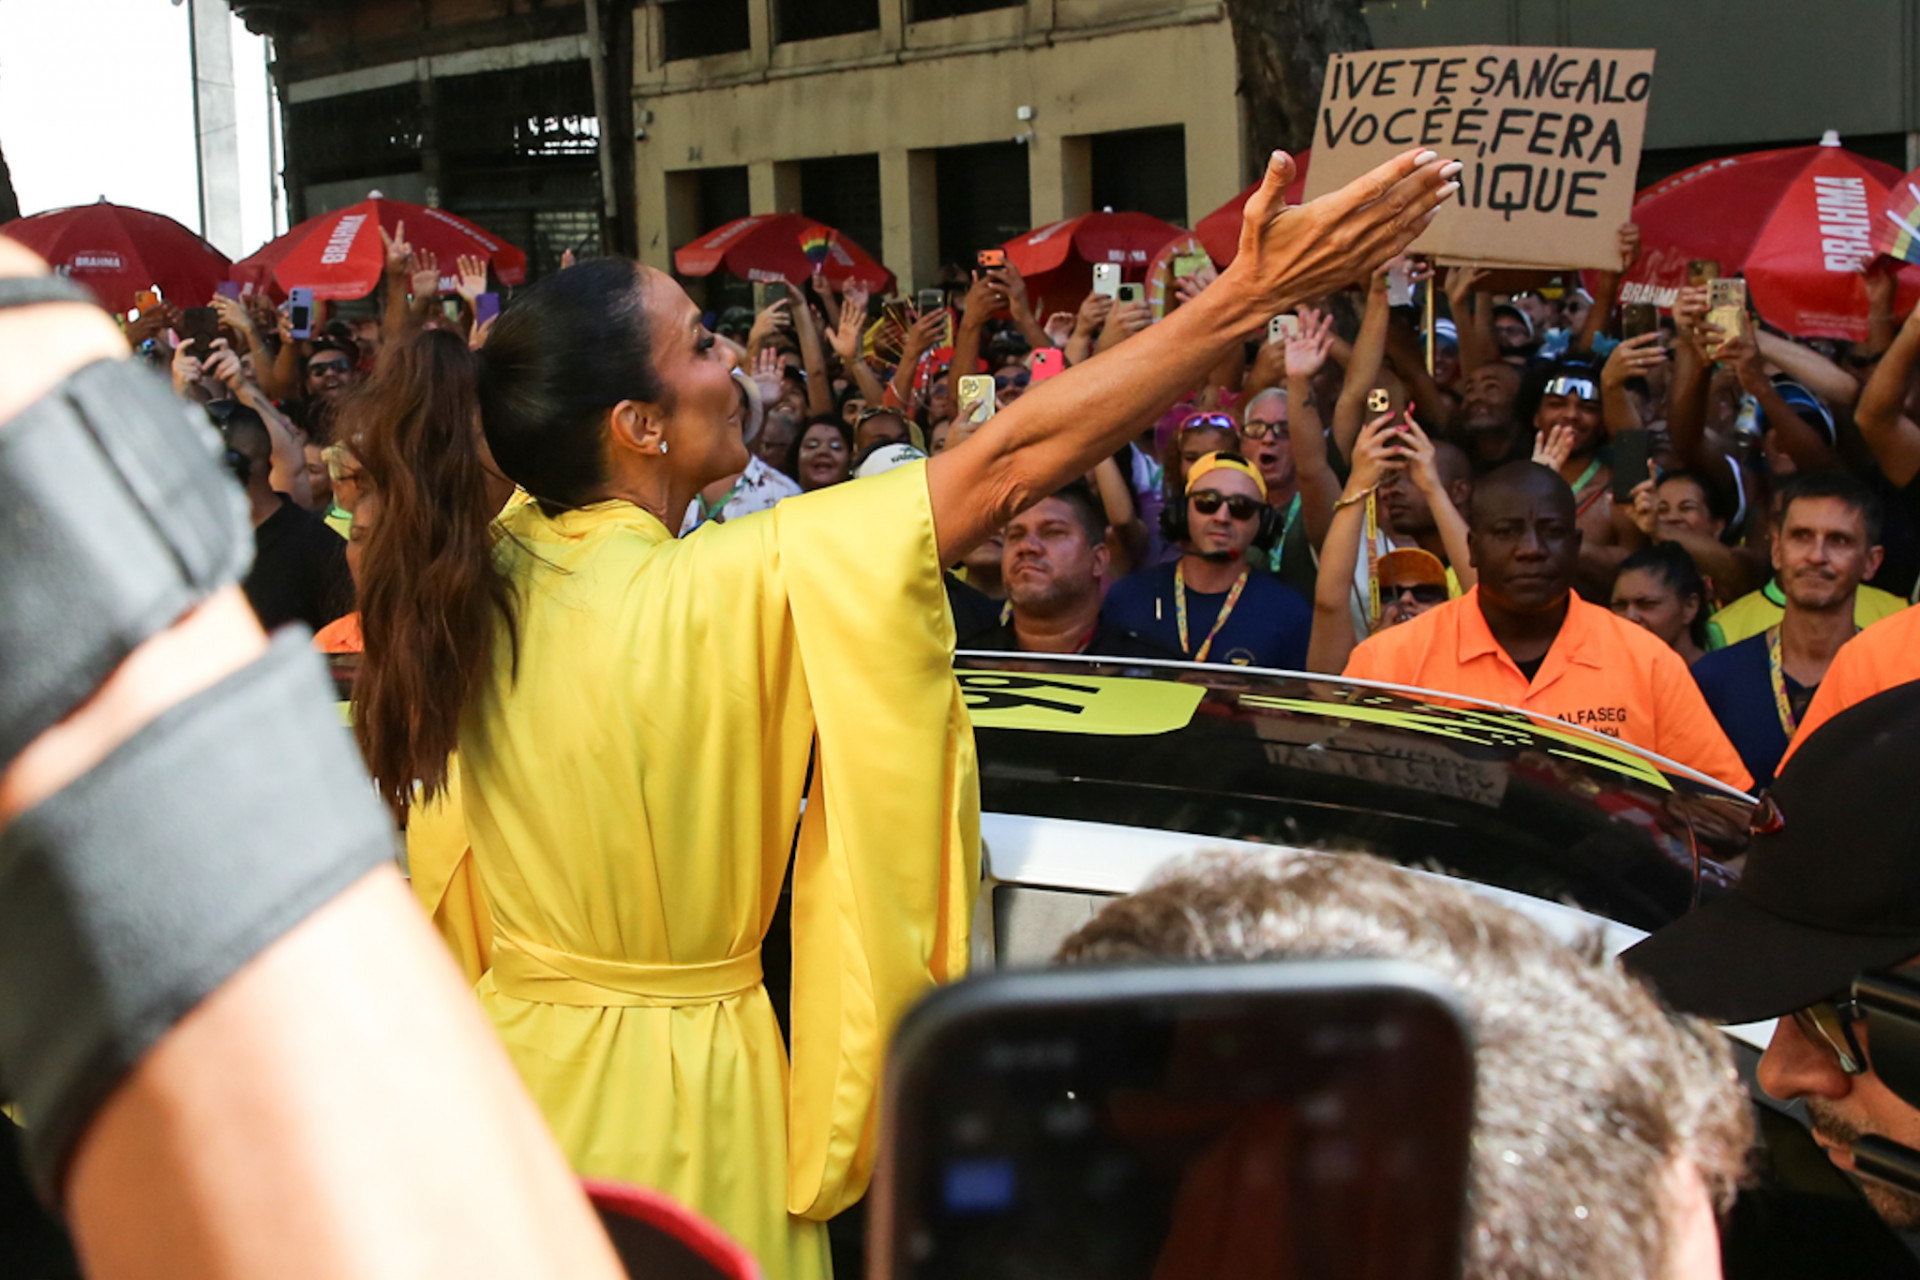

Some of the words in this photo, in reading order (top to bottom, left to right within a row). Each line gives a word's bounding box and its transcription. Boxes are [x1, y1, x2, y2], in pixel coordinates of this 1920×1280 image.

[1470, 52, 1652, 105] SANGALO
[1323, 95, 1452, 149] VOCÊ
[1490, 107, 1622, 165] FERA
[1813, 176, 1875, 272] BRAHMA
[1557, 707, 1627, 725] ALFASEG
